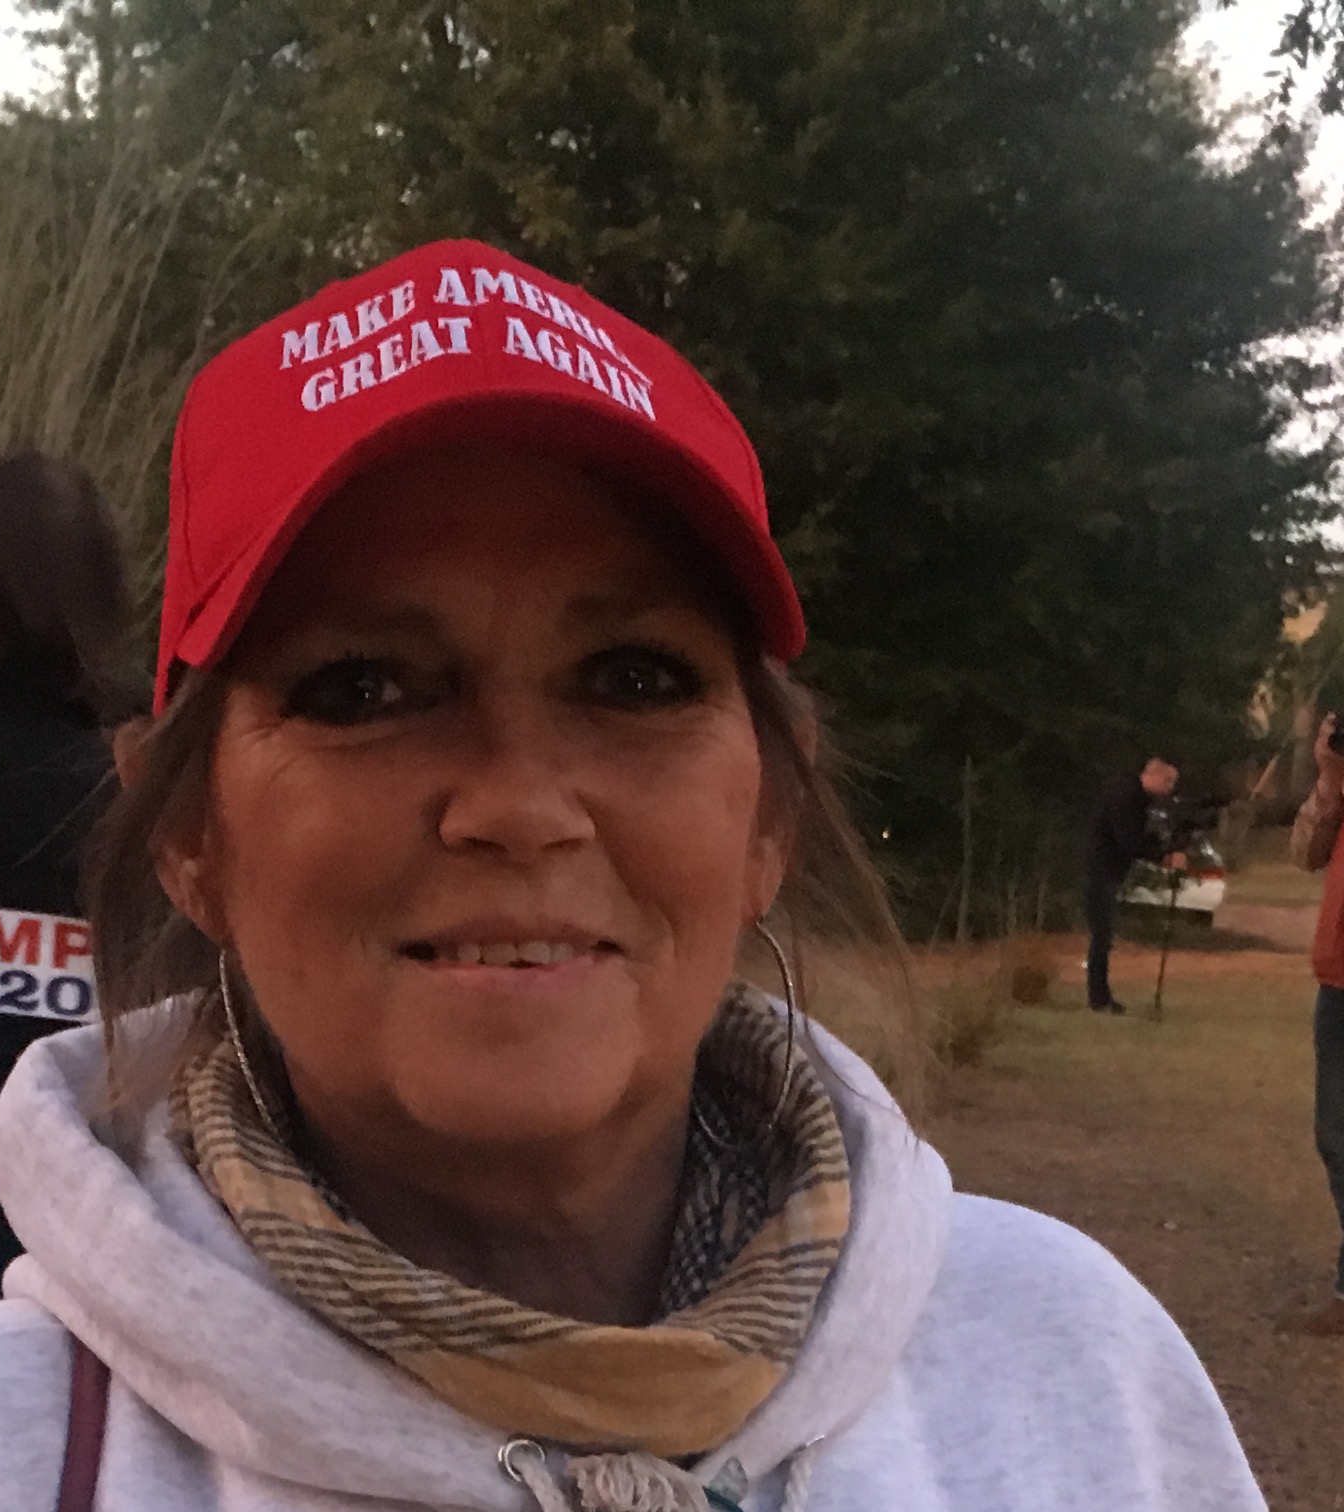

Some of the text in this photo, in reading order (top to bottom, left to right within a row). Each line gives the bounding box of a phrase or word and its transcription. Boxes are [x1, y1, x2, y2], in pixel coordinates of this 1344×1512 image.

[279, 280, 416, 371] MAKE
[300, 316, 656, 422] GREAT AGAIN
